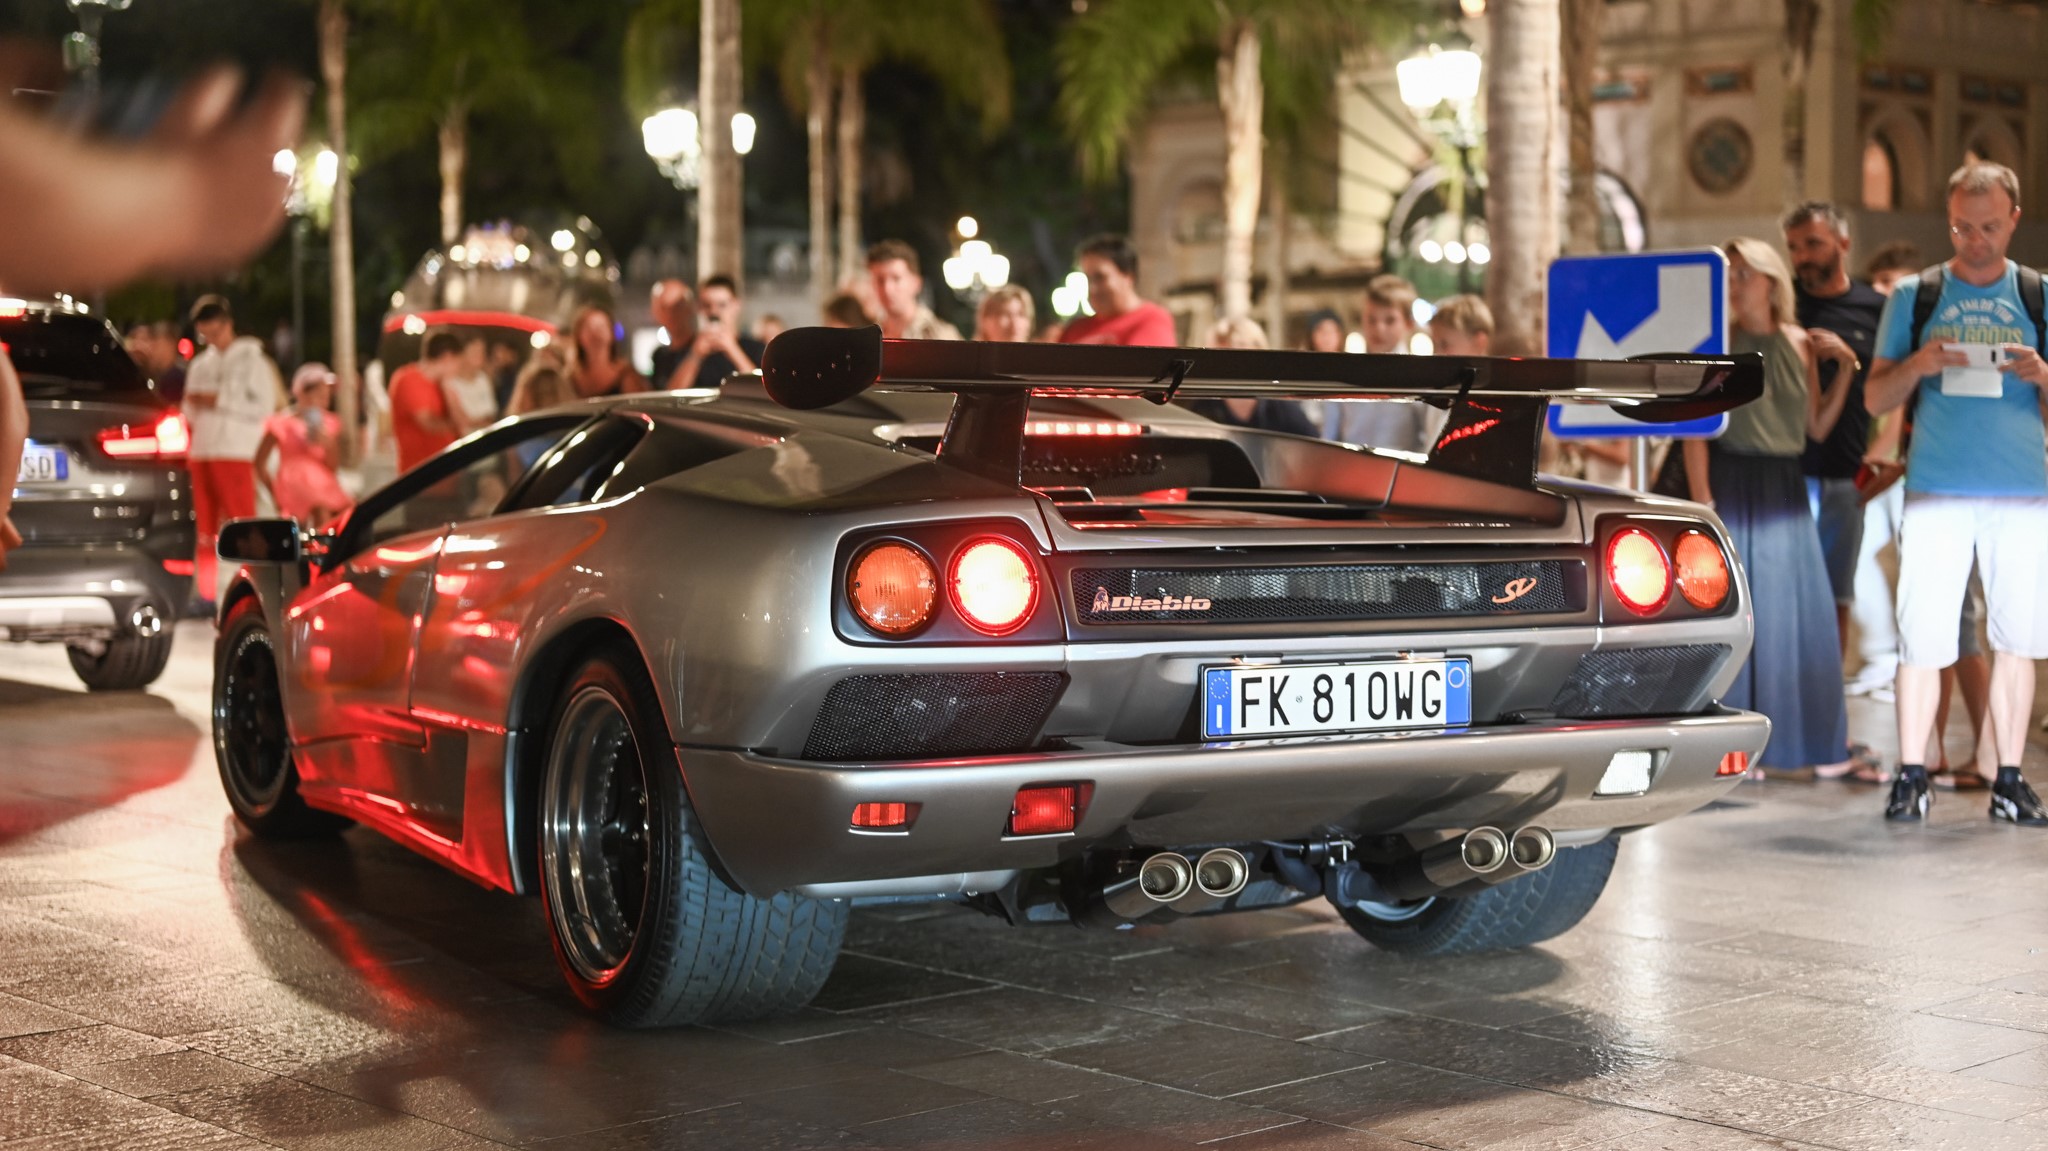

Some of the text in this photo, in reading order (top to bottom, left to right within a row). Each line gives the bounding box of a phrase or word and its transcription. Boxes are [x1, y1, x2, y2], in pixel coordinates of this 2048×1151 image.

[1965, 326, 2023, 344] GOODS
[1110, 595, 1211, 611] Diablo
[1241, 670, 1441, 728] FK 810WG
